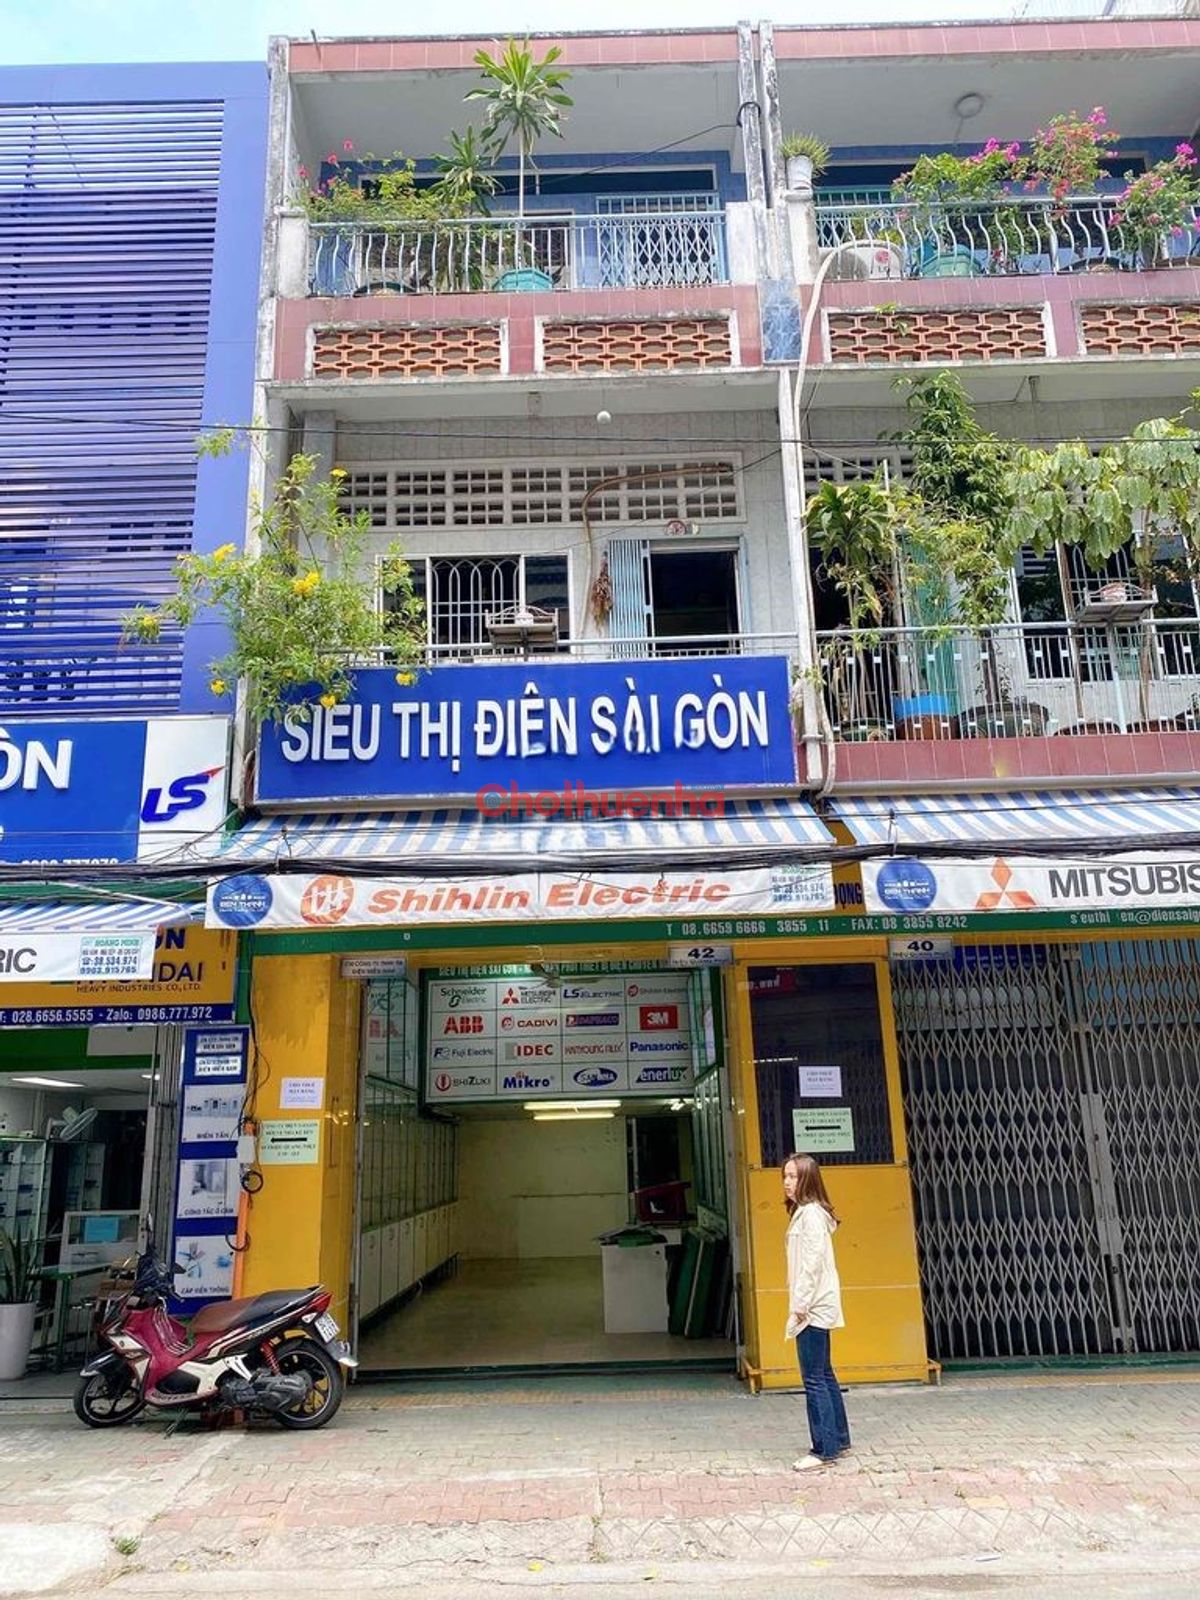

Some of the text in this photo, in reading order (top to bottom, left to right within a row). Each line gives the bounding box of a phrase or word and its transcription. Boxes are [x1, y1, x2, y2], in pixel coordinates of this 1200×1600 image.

[392, 701, 461, 772] THỊ
[591, 677, 660, 754] SÀI
[674, 674, 768, 750] GÒN
[140, 774, 210, 823] LS
[368, 879, 731, 914] Shihlin Electric
[851, 918, 879, 930] FAX:
[903, 915, 934, 929] 3855
[937, 915, 968, 928] 8242
[907, 940, 934, 951] 40
[688, 947, 714, 959] 42
[77, 985, 106, 993] HEAVY
[440, 986, 487, 997] Schneider
[12, 1010, 93, 1024] 028.6656.5555
[137, 1007, 212, 1020] 0986.777.972
[647, 1012, 669, 1024] 3M
[444, 1016, 484, 1034] ABB
[517, 1019, 557, 1028] CADIVI
[517, 1045, 553, 1056] IDEC
[630, 1040, 688, 1052] Panasonic
[504, 1075, 550, 1089] Mikro
